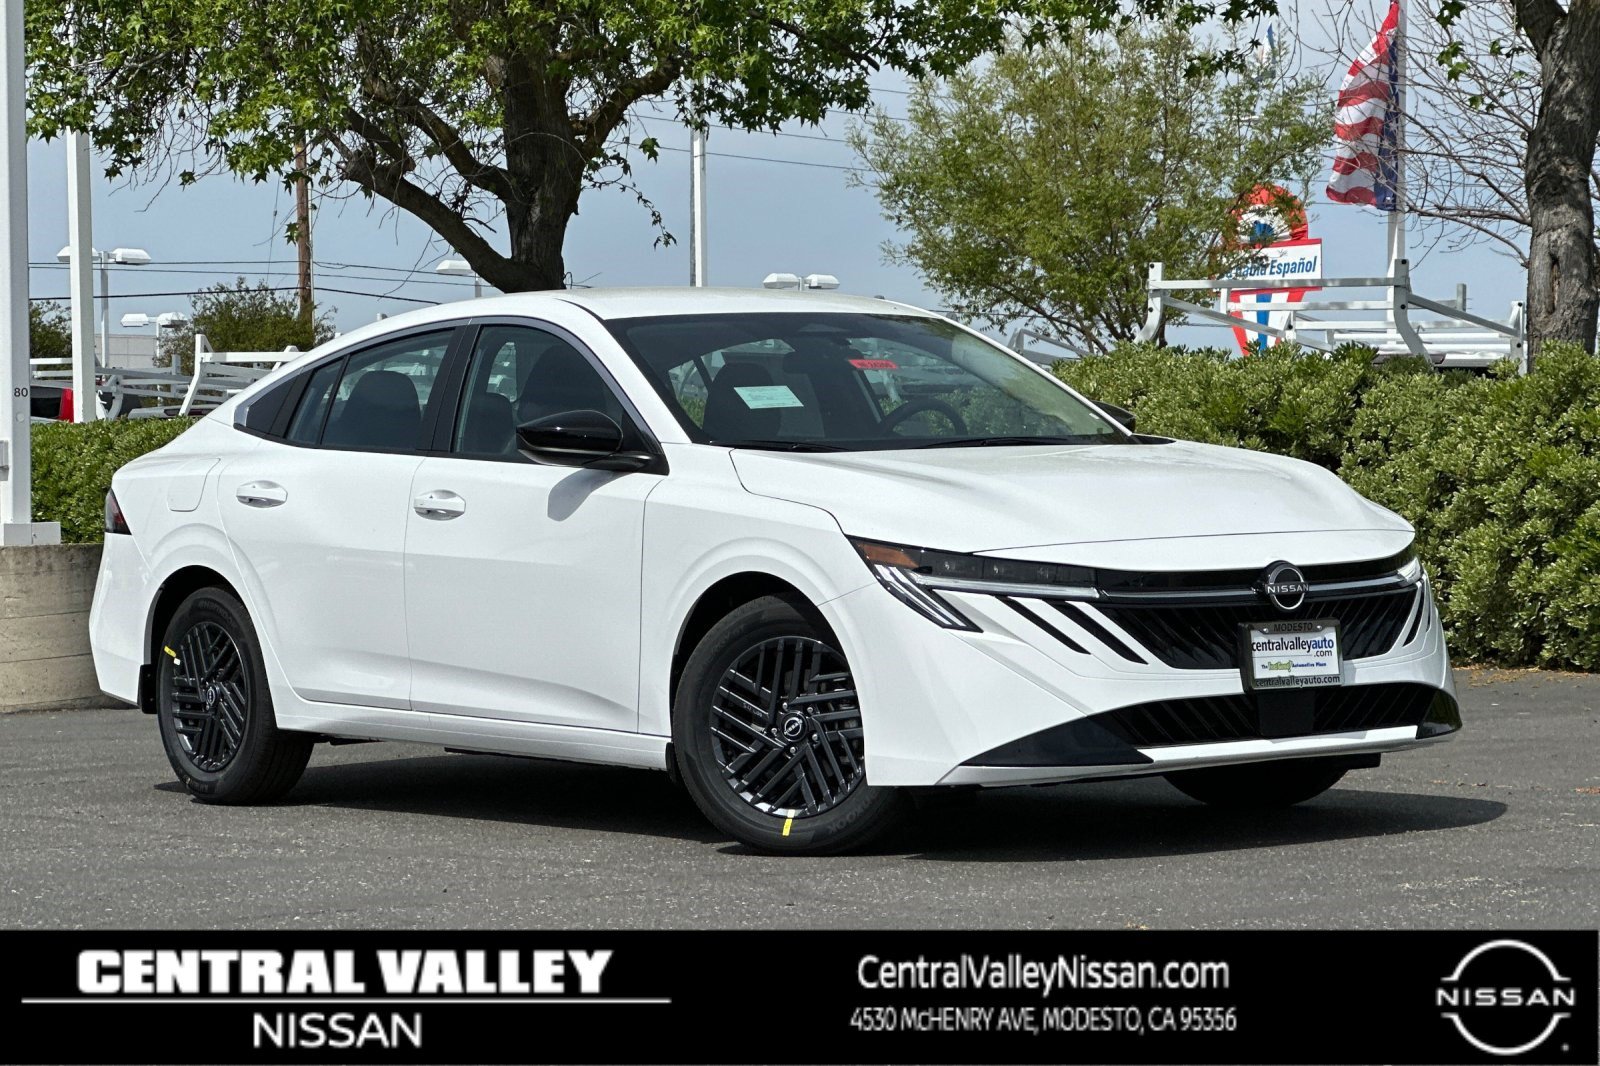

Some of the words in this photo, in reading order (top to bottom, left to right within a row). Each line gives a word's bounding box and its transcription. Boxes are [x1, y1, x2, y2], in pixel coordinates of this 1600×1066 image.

[1269, 256, 1318, 277] Español
[14, 387, 28, 397] 80
[1267, 583, 1309, 594] NISSAN
[1273, 622, 1314, 632] MODESTO
[1251, 637, 1335, 653] centralvalleyauto
[1255, 675, 1340, 687] centralvalleyauto.com
